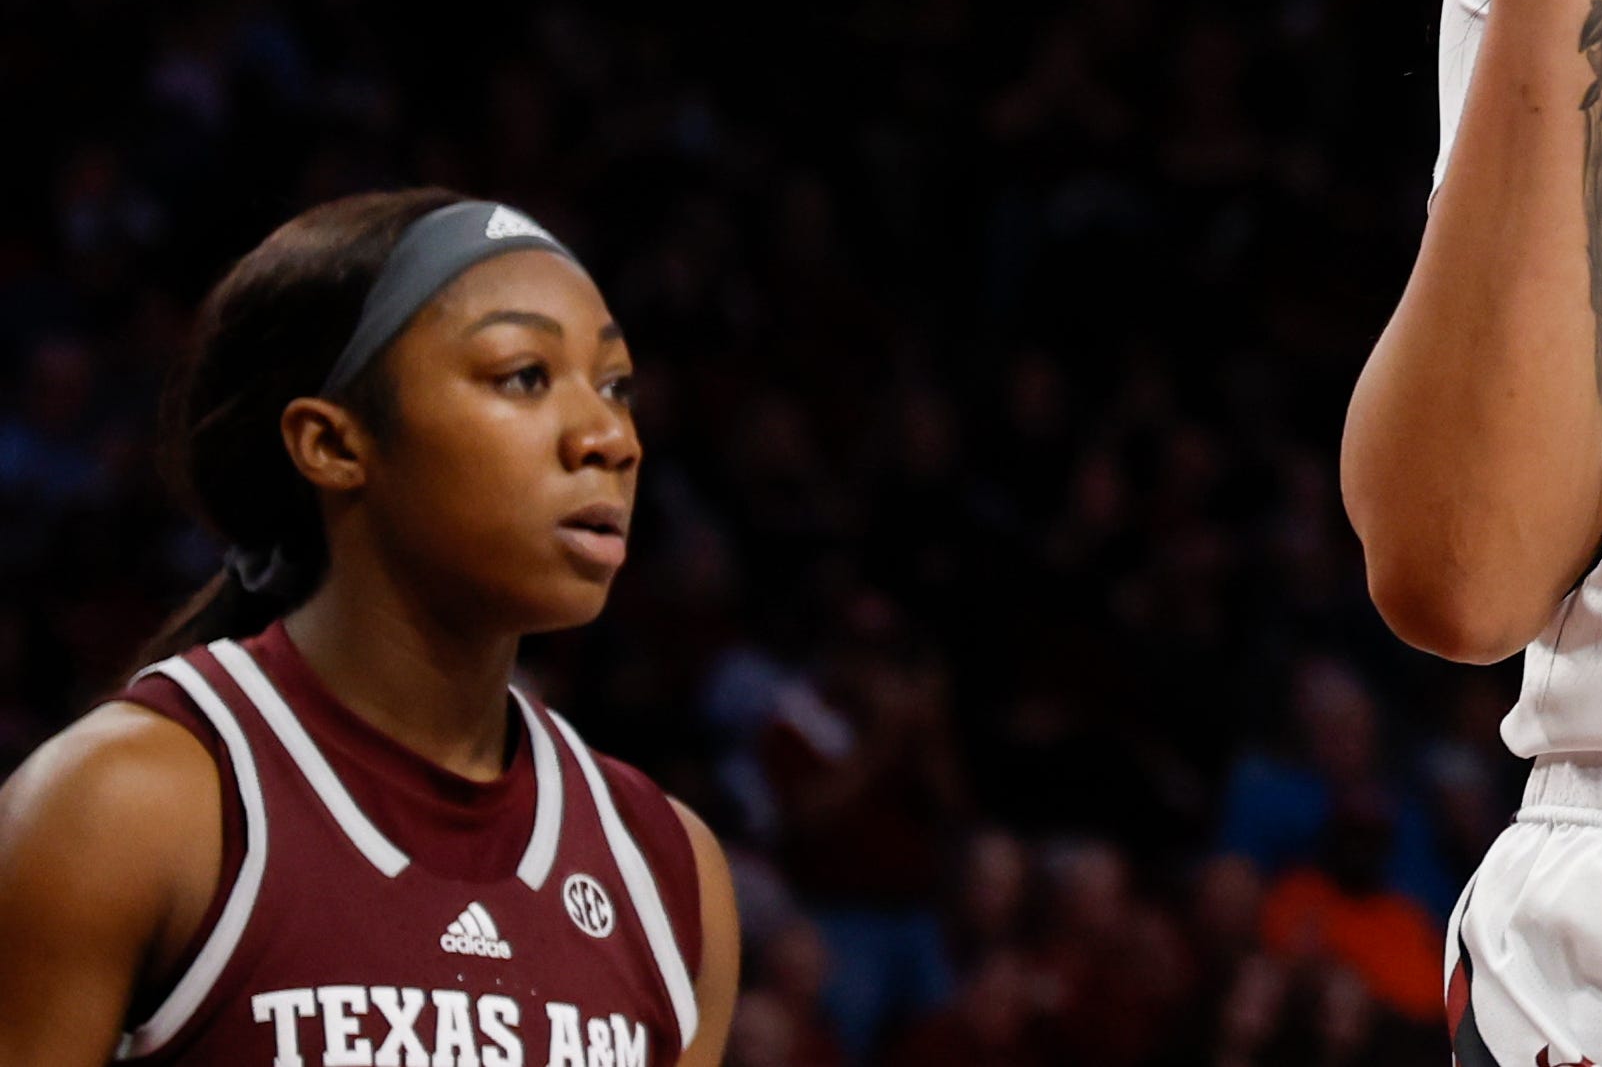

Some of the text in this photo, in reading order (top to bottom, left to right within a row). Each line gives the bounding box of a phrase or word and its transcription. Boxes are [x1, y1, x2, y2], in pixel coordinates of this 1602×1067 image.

[568, 880, 608, 932] SEC
[440, 933, 512, 960] adidas
[251, 985, 648, 1067] TEXAS A&M
